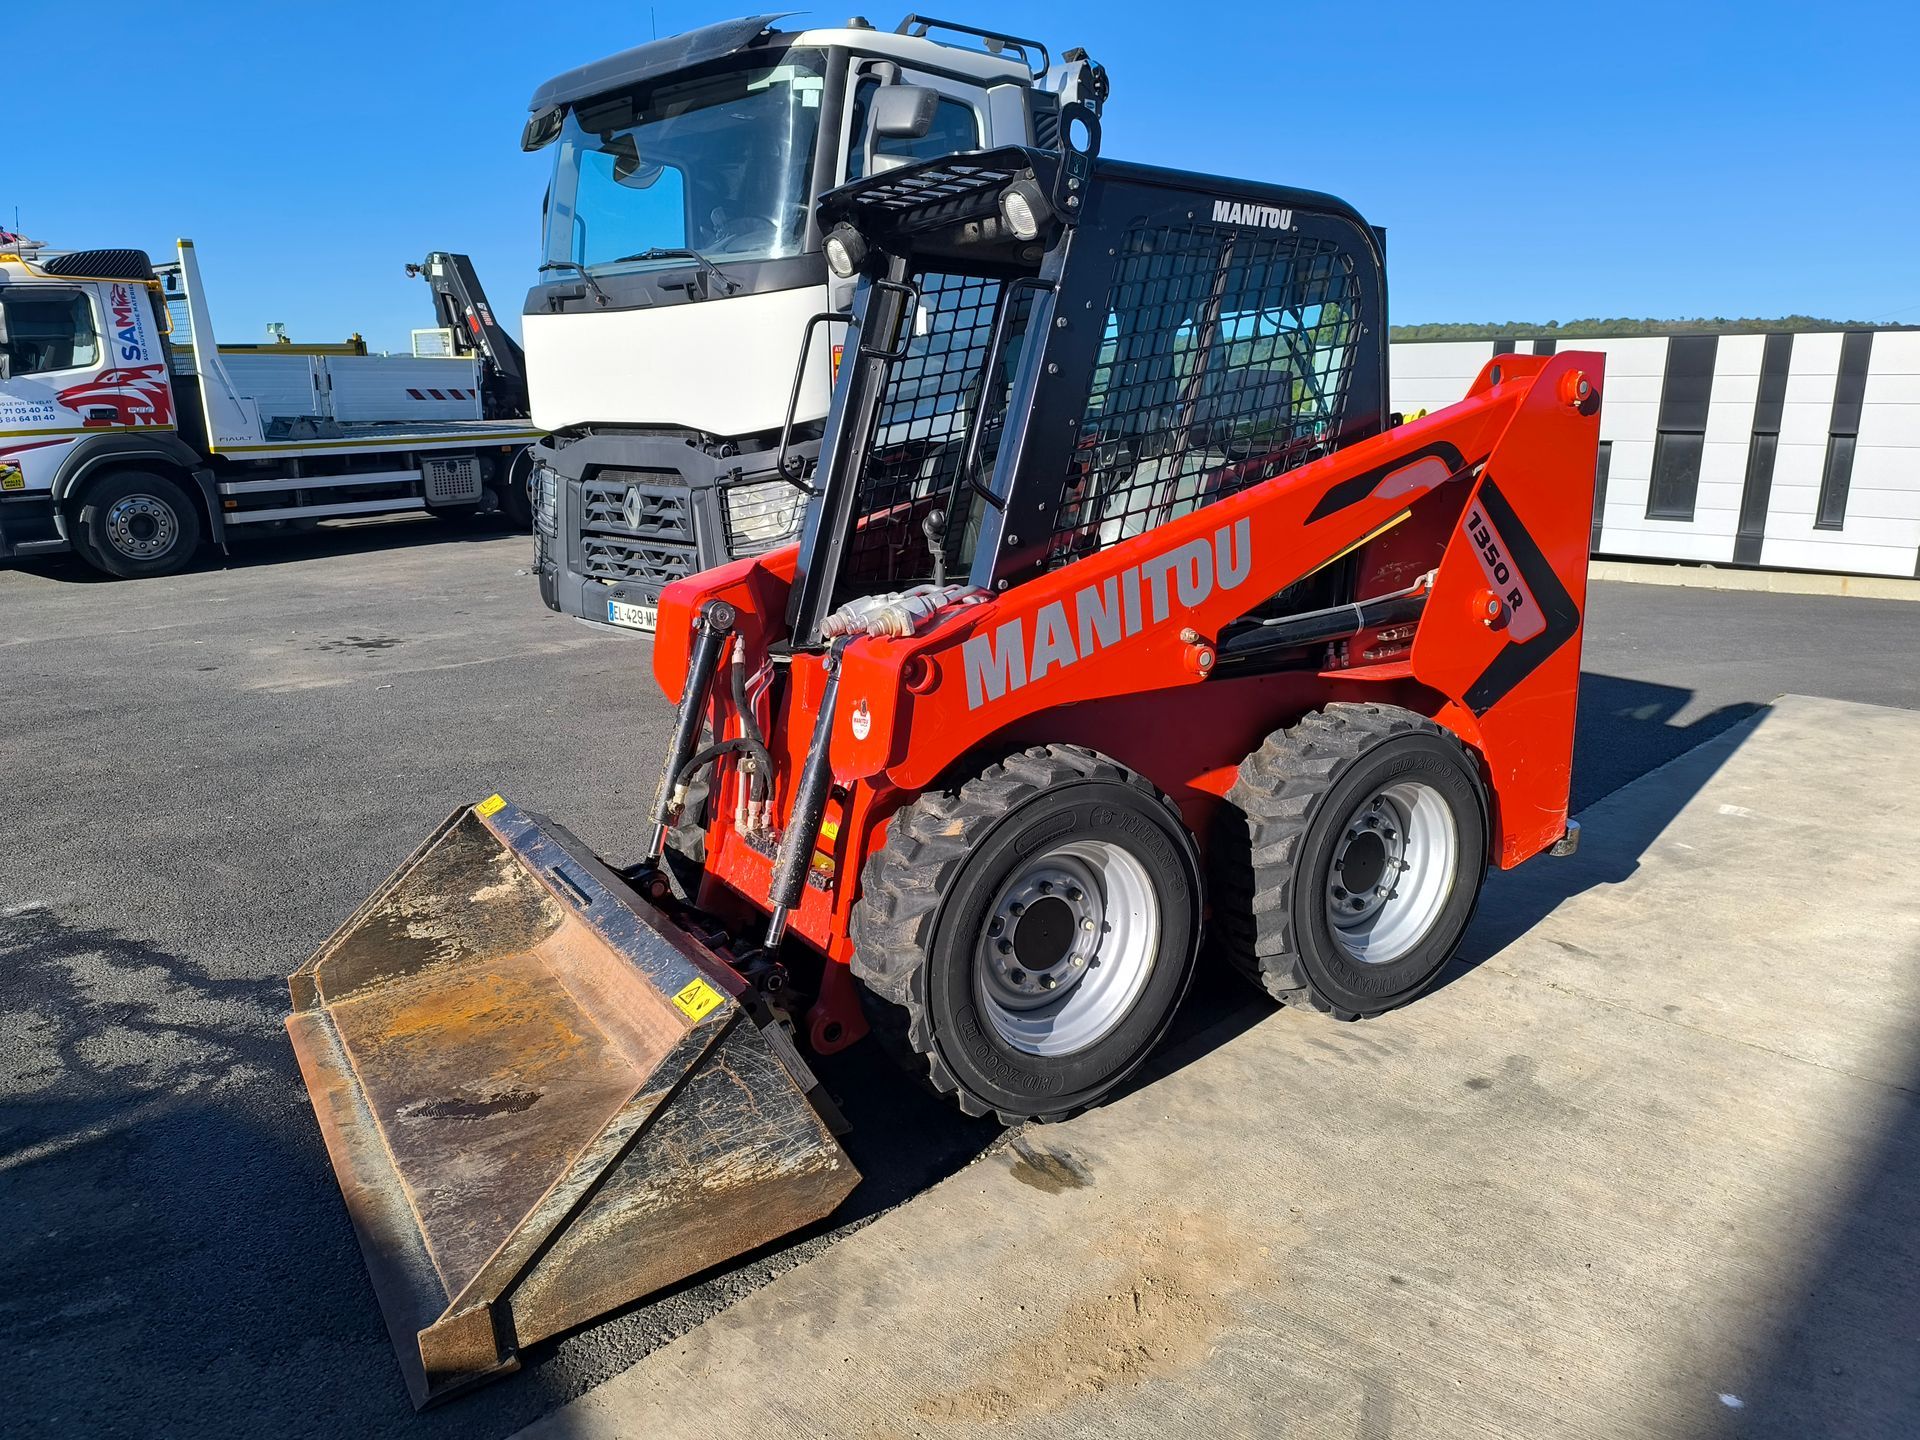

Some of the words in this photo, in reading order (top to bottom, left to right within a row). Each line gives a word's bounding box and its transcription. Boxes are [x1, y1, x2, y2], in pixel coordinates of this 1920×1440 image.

[1212, 200, 1293, 230] MANITOU
[1468, 511, 1509, 585] 1350
[1507, 587, 1523, 613] R
[962, 516, 1251, 711] MANITOU
[1118, 812, 1178, 871] TITAN
